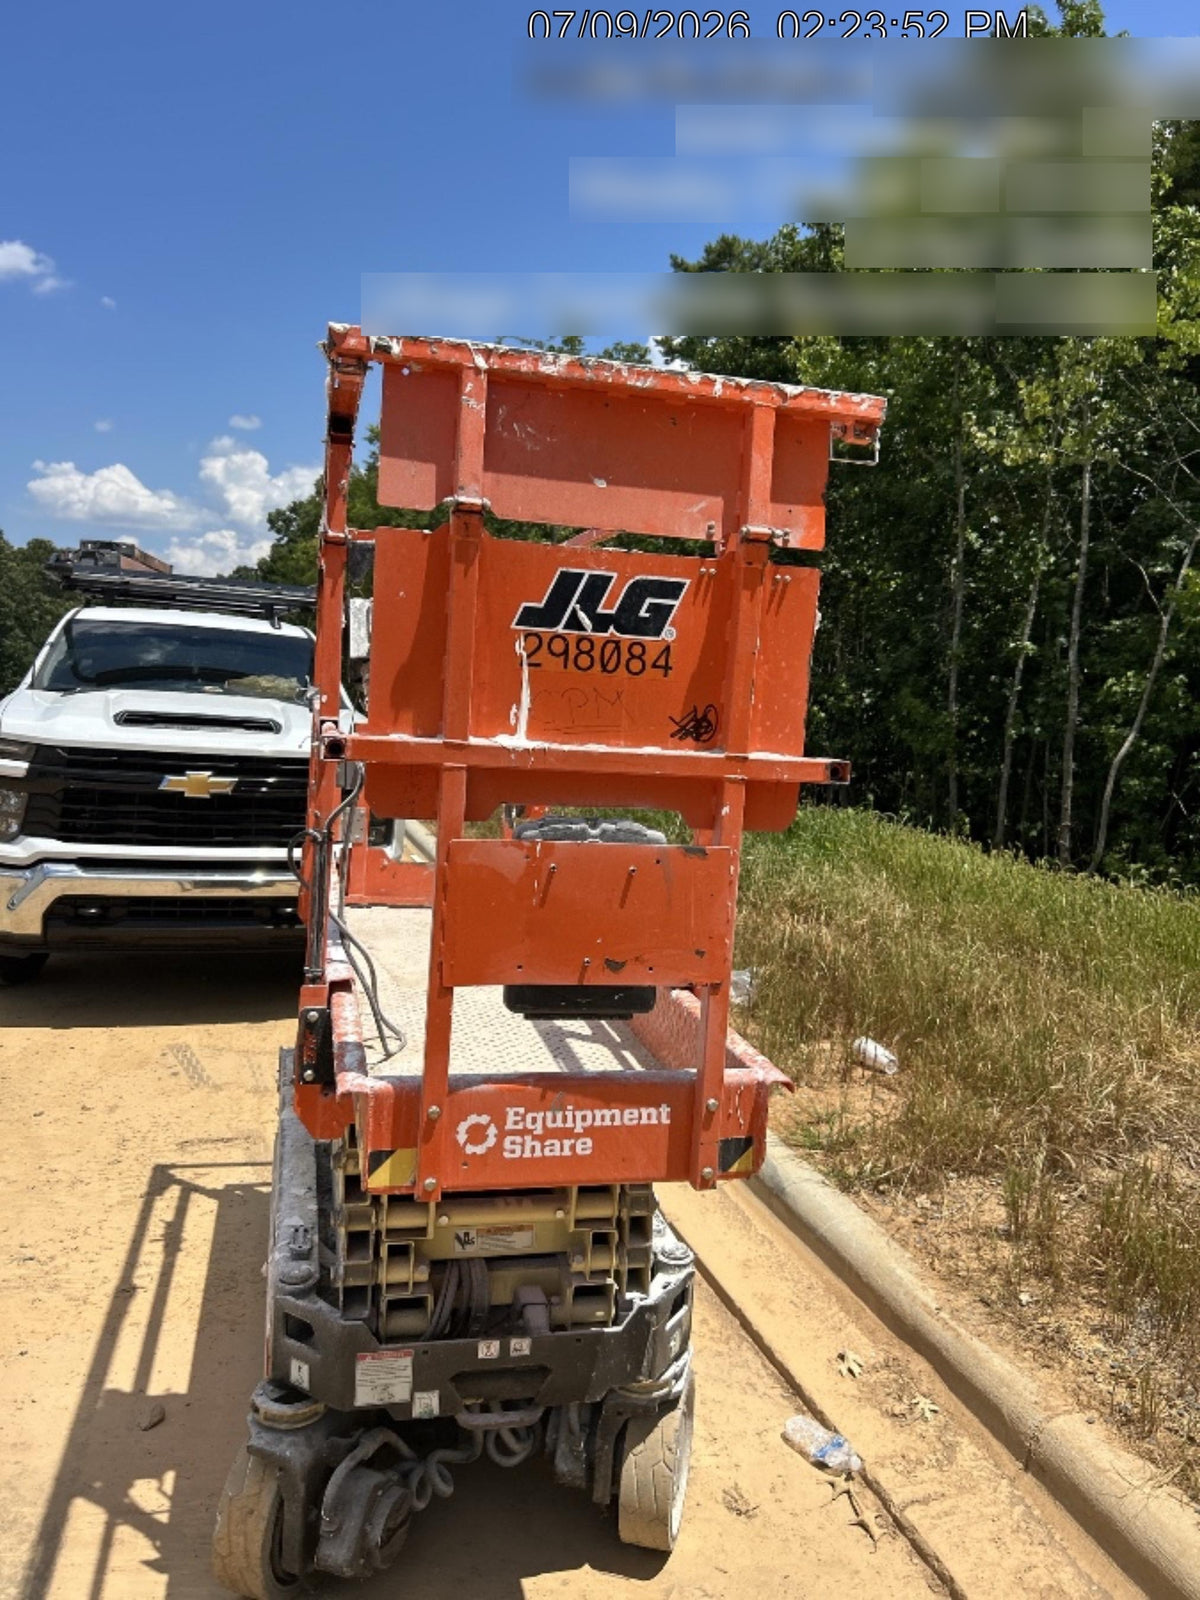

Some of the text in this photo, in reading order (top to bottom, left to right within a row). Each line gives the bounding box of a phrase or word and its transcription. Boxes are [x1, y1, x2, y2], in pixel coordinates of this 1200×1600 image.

[511, 567, 692, 640] JLG
[519, 632, 673, 678] 298084
[504, 1103, 671, 1133] Equipment
[503, 1136, 593, 1159] Share
